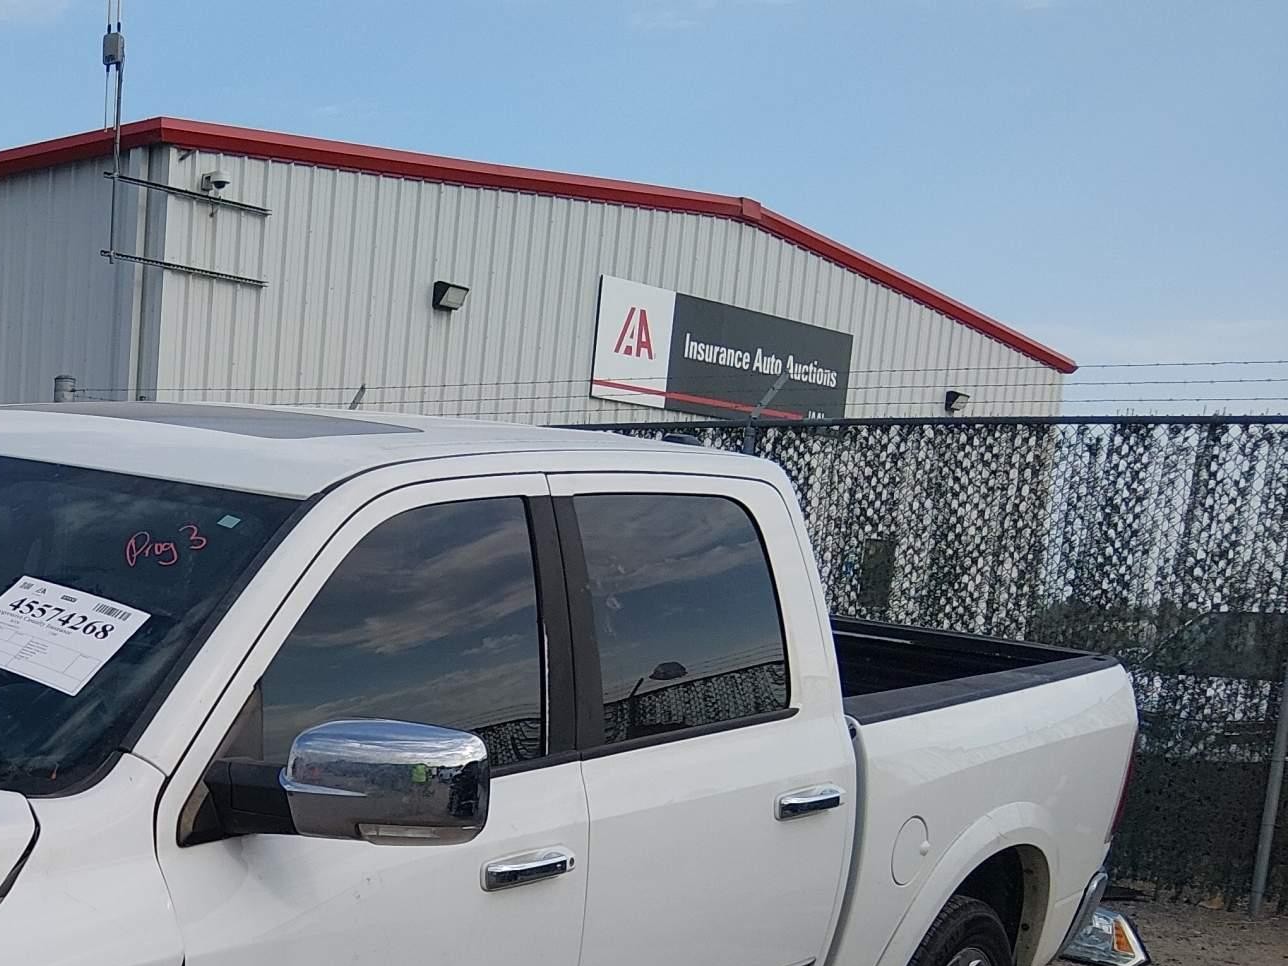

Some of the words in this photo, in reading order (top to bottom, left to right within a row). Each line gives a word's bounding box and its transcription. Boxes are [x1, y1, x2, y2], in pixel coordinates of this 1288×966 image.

[683, 333, 750, 370] Insurance
[753, 347, 782, 375] Auto
[786, 354, 838, 388] Auctions
[178, 524, 207, 550] 3
[8, 597, 116, 641] 45574268
